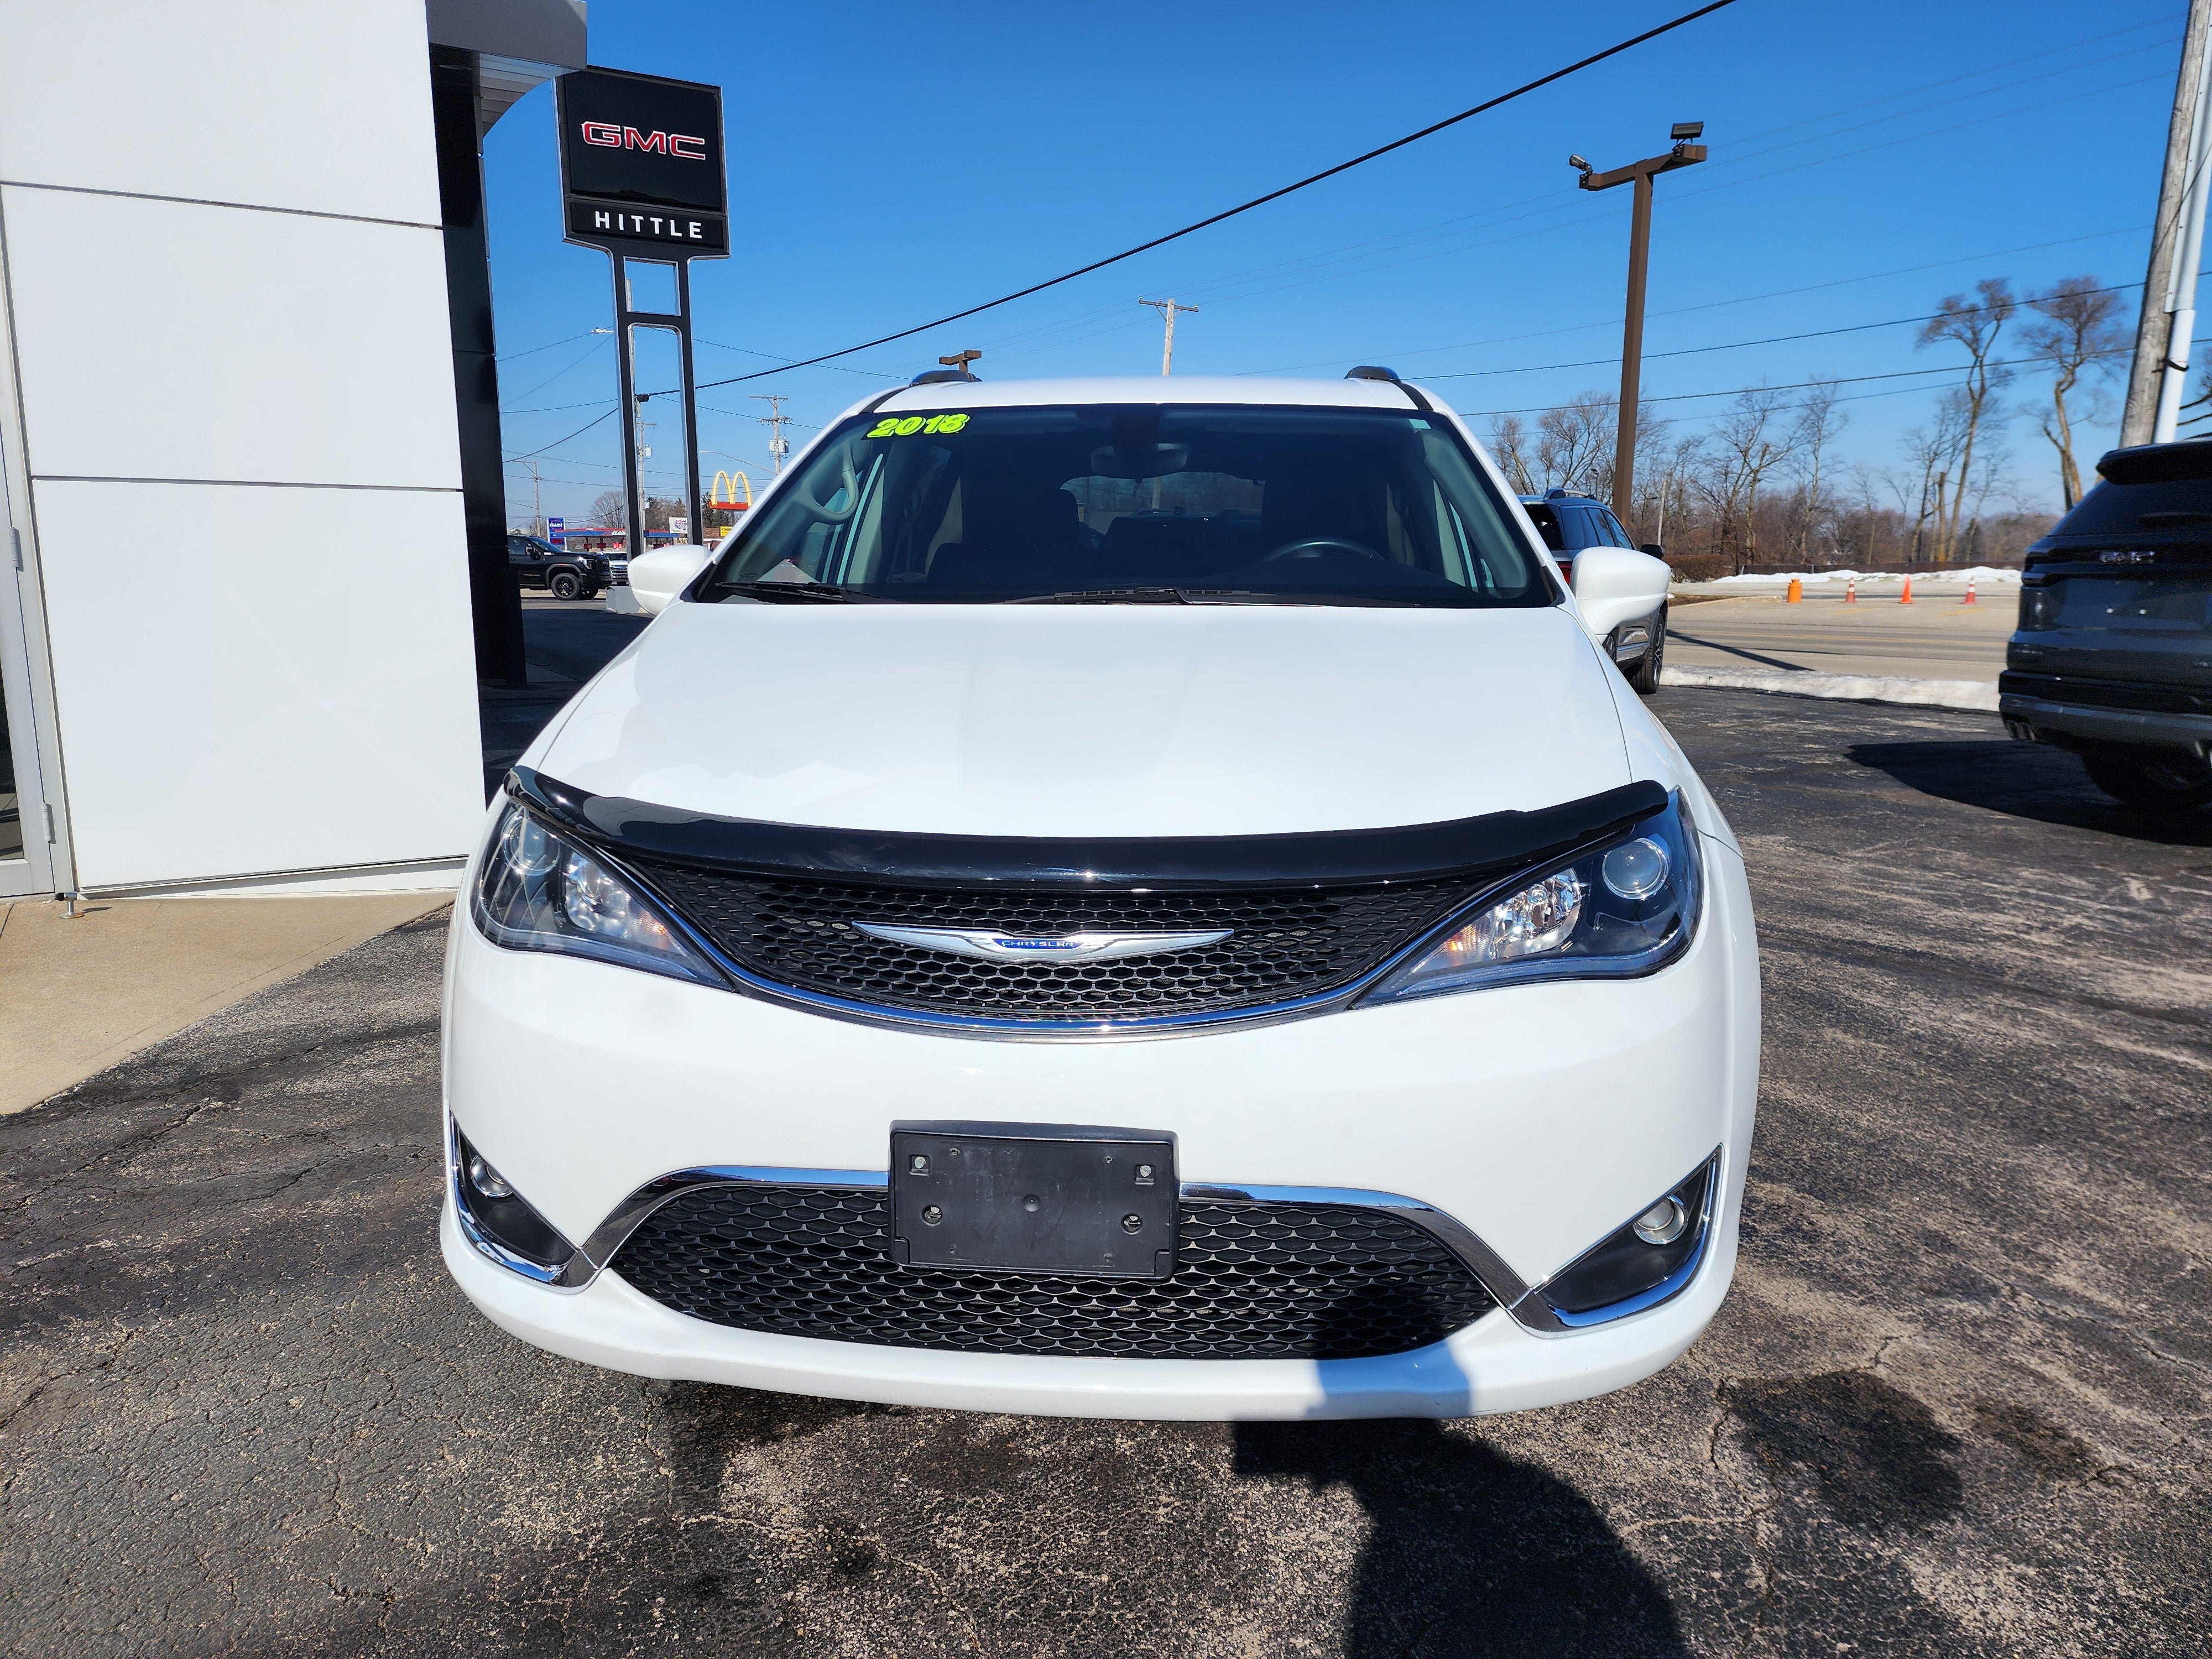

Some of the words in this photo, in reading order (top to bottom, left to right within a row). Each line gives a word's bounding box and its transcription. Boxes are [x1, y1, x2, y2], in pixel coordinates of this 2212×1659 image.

[581, 121, 706, 160] GMC
[595, 211, 702, 239] HITTLE
[867, 414, 971, 438] 2018
